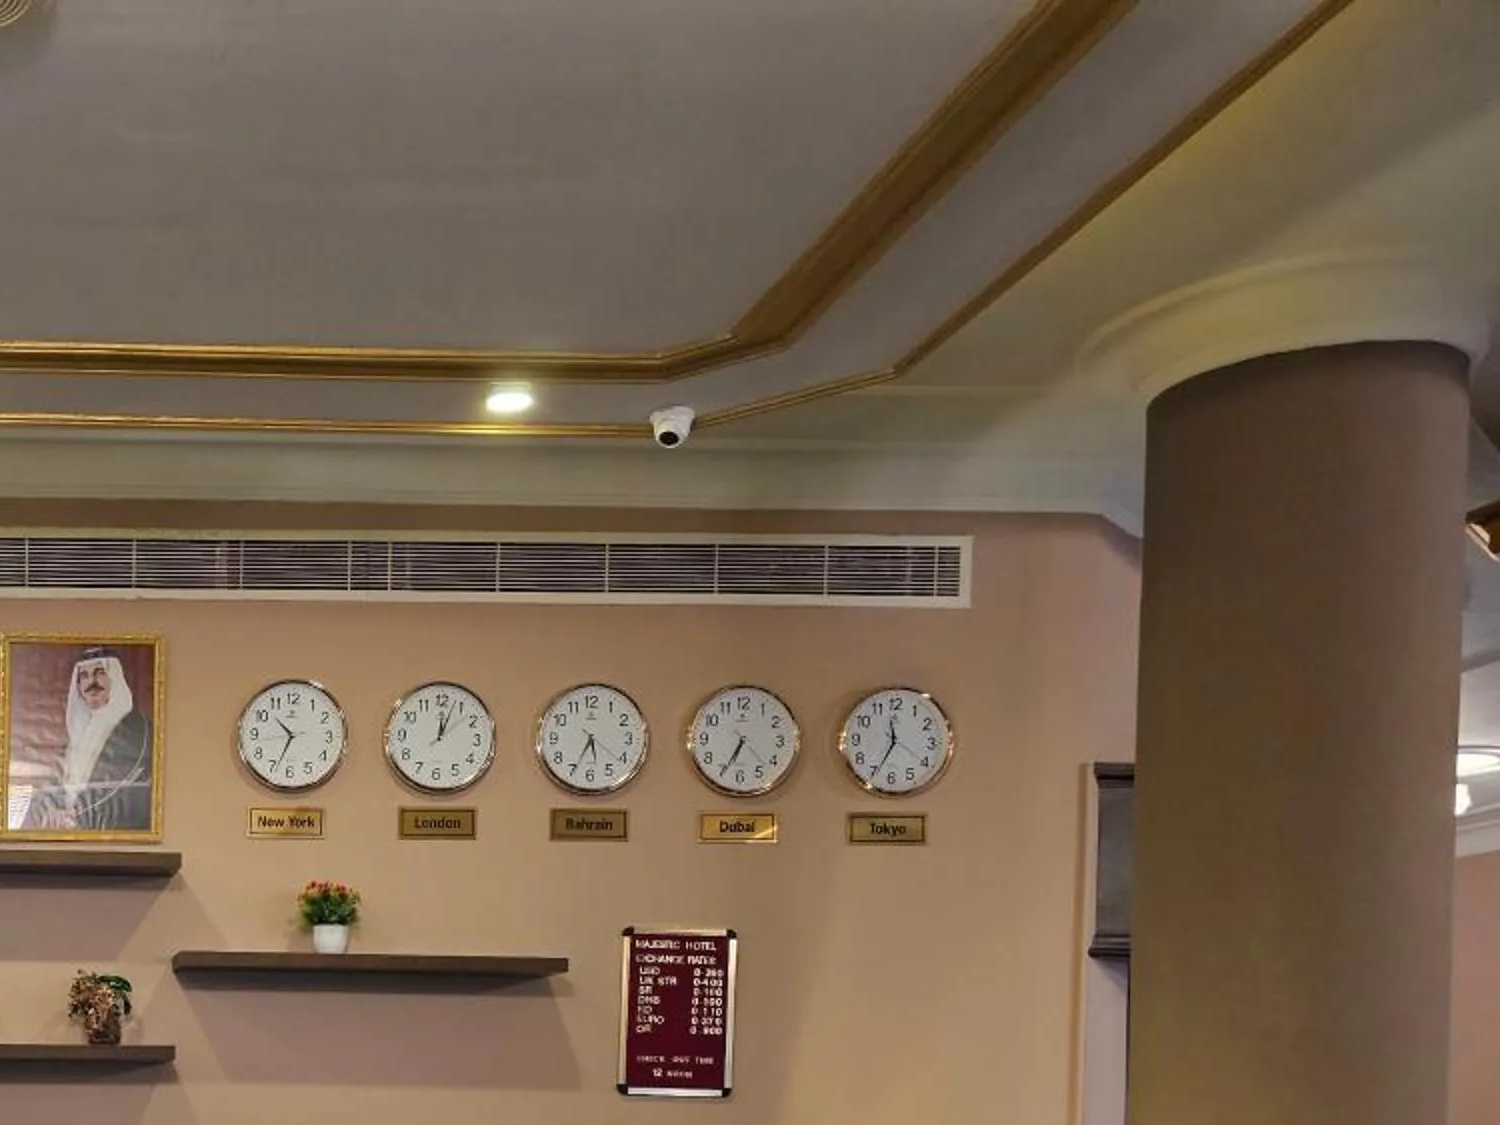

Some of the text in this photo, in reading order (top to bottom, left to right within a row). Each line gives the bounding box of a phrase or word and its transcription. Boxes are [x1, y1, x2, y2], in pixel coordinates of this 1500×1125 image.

[270, 697, 281, 710] 11
[286, 693, 301, 705] 12
[419, 699, 429, 712] 11
[436, 694, 449, 707] 12
[585, 695, 599, 709] 12
[737, 697, 750, 711] 12
[889, 698, 903, 711] 12
[568, 701, 579, 714] 11
[720, 702, 731, 714] 11
[872, 703, 883, 716] 11
[256, 709, 269, 722] 10
[320, 712, 329, 724] 2
[404, 711, 416, 724] 10
[469, 715, 478, 728] 2
[554, 714, 567, 727] 10
[619, 714, 629, 727] 2
[706, 714, 719, 727] 10
[857, 715, 871, 728] 10
[771, 716, 781, 729] 2
[923, 718, 932, 731] 2
[250, 727, 258, 741] 9
[325, 731, 333, 744] 3
[398, 728, 407, 741] 9
[473, 733, 481, 747] 3
[549, 732, 558, 745] 9
[625, 733, 633, 745] 3
[700, 732, 709, 745] 9
[852, 734, 861, 747] 9
[776, 736, 785, 748] 3
[927, 737, 936, 750] 3
[254, 747, 263, 760] 8
[319, 750, 327, 761] 4
[402, 748, 411, 760] 8
[466, 753, 474, 764] 4
[554, 751, 563, 764] 8
[619, 752, 627, 764] 4
[704, 752, 713, 764] 8
[855, 752, 865, 765] 8
[268, 760, 277, 773] 7
[769, 754, 777, 767] 4
[920, 757, 929, 768] 4
[286, 766, 294, 779] 6
[304, 762, 313, 775] 5
[415, 762, 423, 774] 7
[432, 768, 441, 780] 6
[451, 764, 459, 777] 5
[568, 764, 577, 776] 7
[604, 764, 613, 777] 5
[754, 765, 763, 779] 5
[870, 765, 878, 777] 7
[905, 768, 914, 781] 5
[586, 769, 595, 782] 6
[736, 770, 745, 783] 6
[887, 772, 896, 784] 6
[257, 815, 315, 828] New York
[414, 817, 461, 829] London
[566, 817, 613, 831] Bahrain
[719, 821, 755, 833] Dubai
[870, 823, 906, 836] Tokyo
[635, 939, 717, 951] MAJESTIC HOTEL
[652, 1067, 663, 1077] 12
